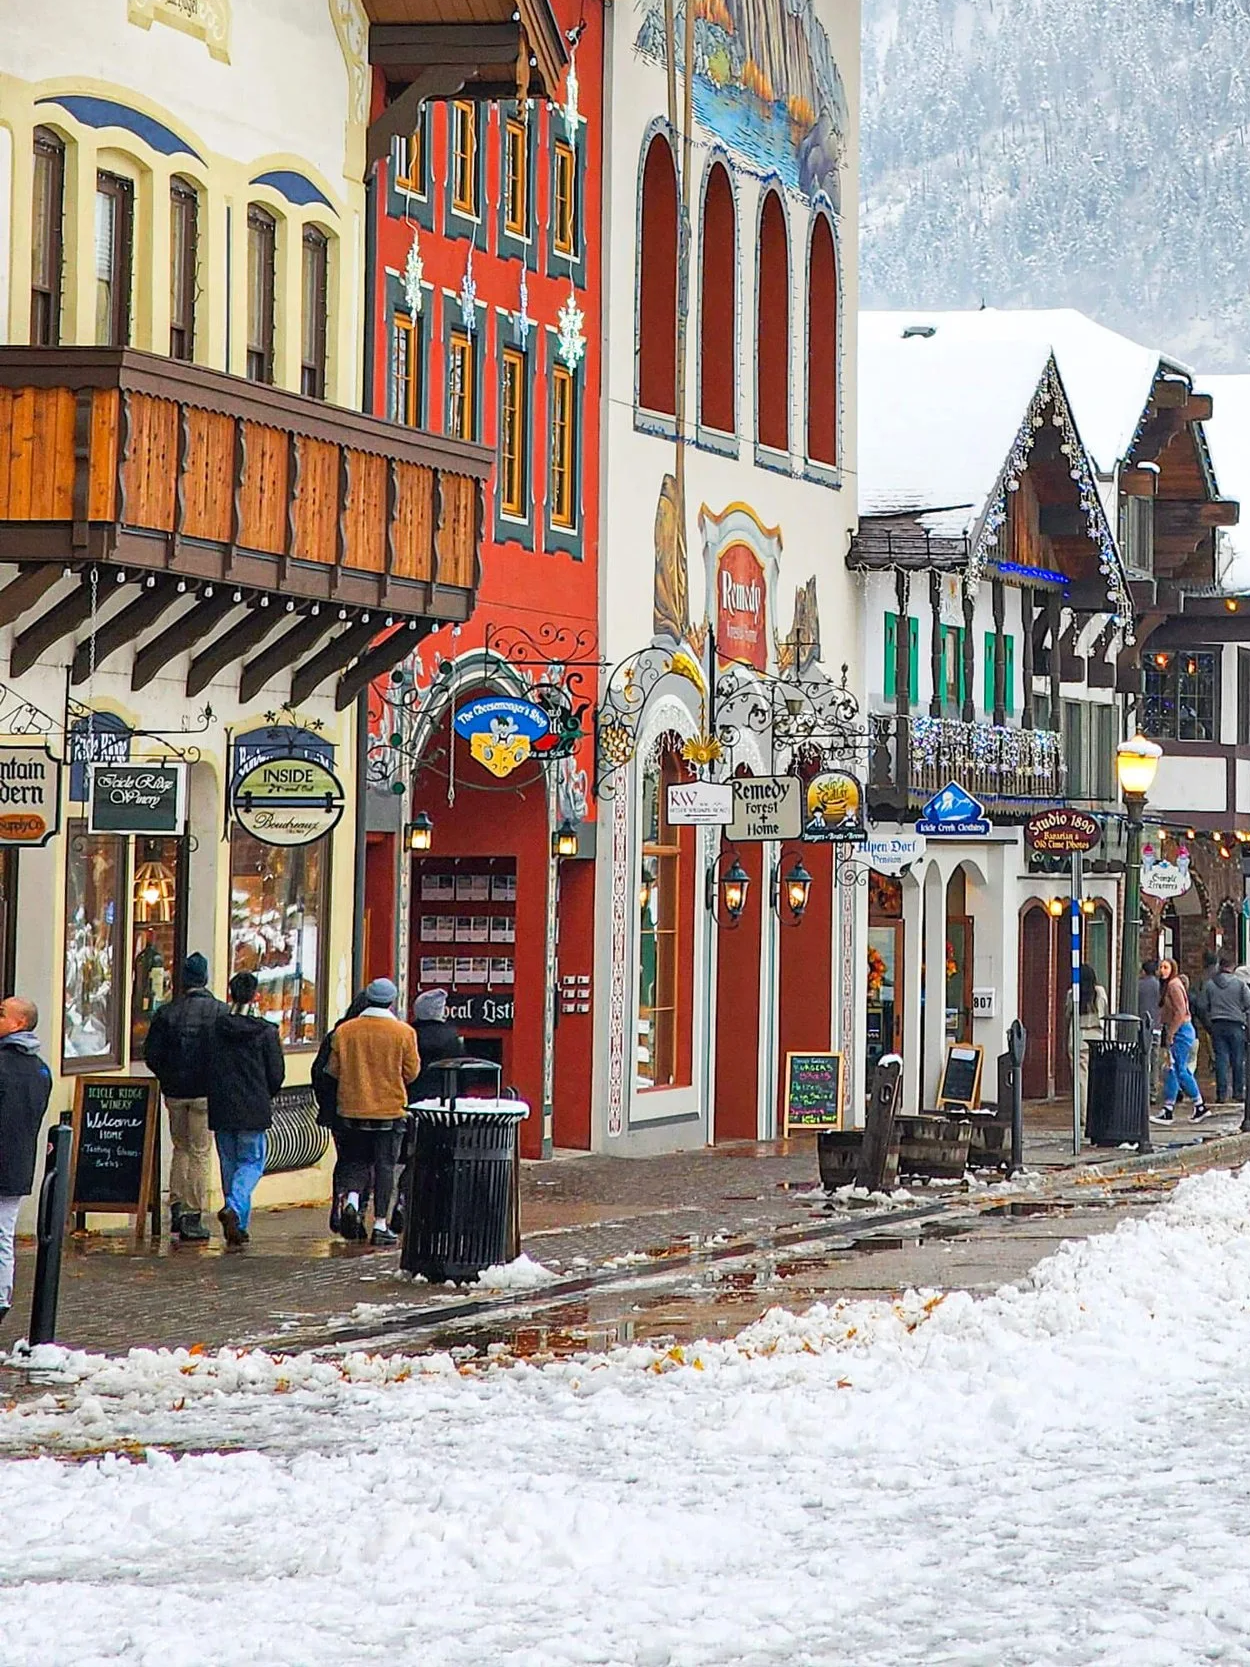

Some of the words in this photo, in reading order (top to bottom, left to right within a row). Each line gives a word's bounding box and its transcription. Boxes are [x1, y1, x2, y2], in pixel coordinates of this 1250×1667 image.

[722, 570, 760, 625] Remedy
[457, 711, 473, 724] The
[530, 709, 547, 728] Shop
[263, 769, 314, 783] INSIDE
[97, 774, 134, 790] Icicle
[134, 774, 174, 794] Ridge
[733, 778, 790, 802] Remedy
[110, 789, 160, 809] Winery
[670, 790, 698, 807] KW
[746, 802, 778, 814] Forest
[747, 823, 780, 836] Home
[1028, 811, 1067, 836] Studio
[1071, 815, 1096, 835] 1890
[890, 839, 916, 853] Dorf
[1033, 839, 1047, 849] Old
[443, 998, 473, 1019] ocal
[973, 997, 993, 1009] 807
[88, 1087, 115, 1099] ICICLE
[118, 1087, 145, 1100] RIDGE
[100, 1099, 133, 1111] WINERY
[86, 1112, 143, 1129] Welcome
[99, 1130, 124, 1141] HOME
